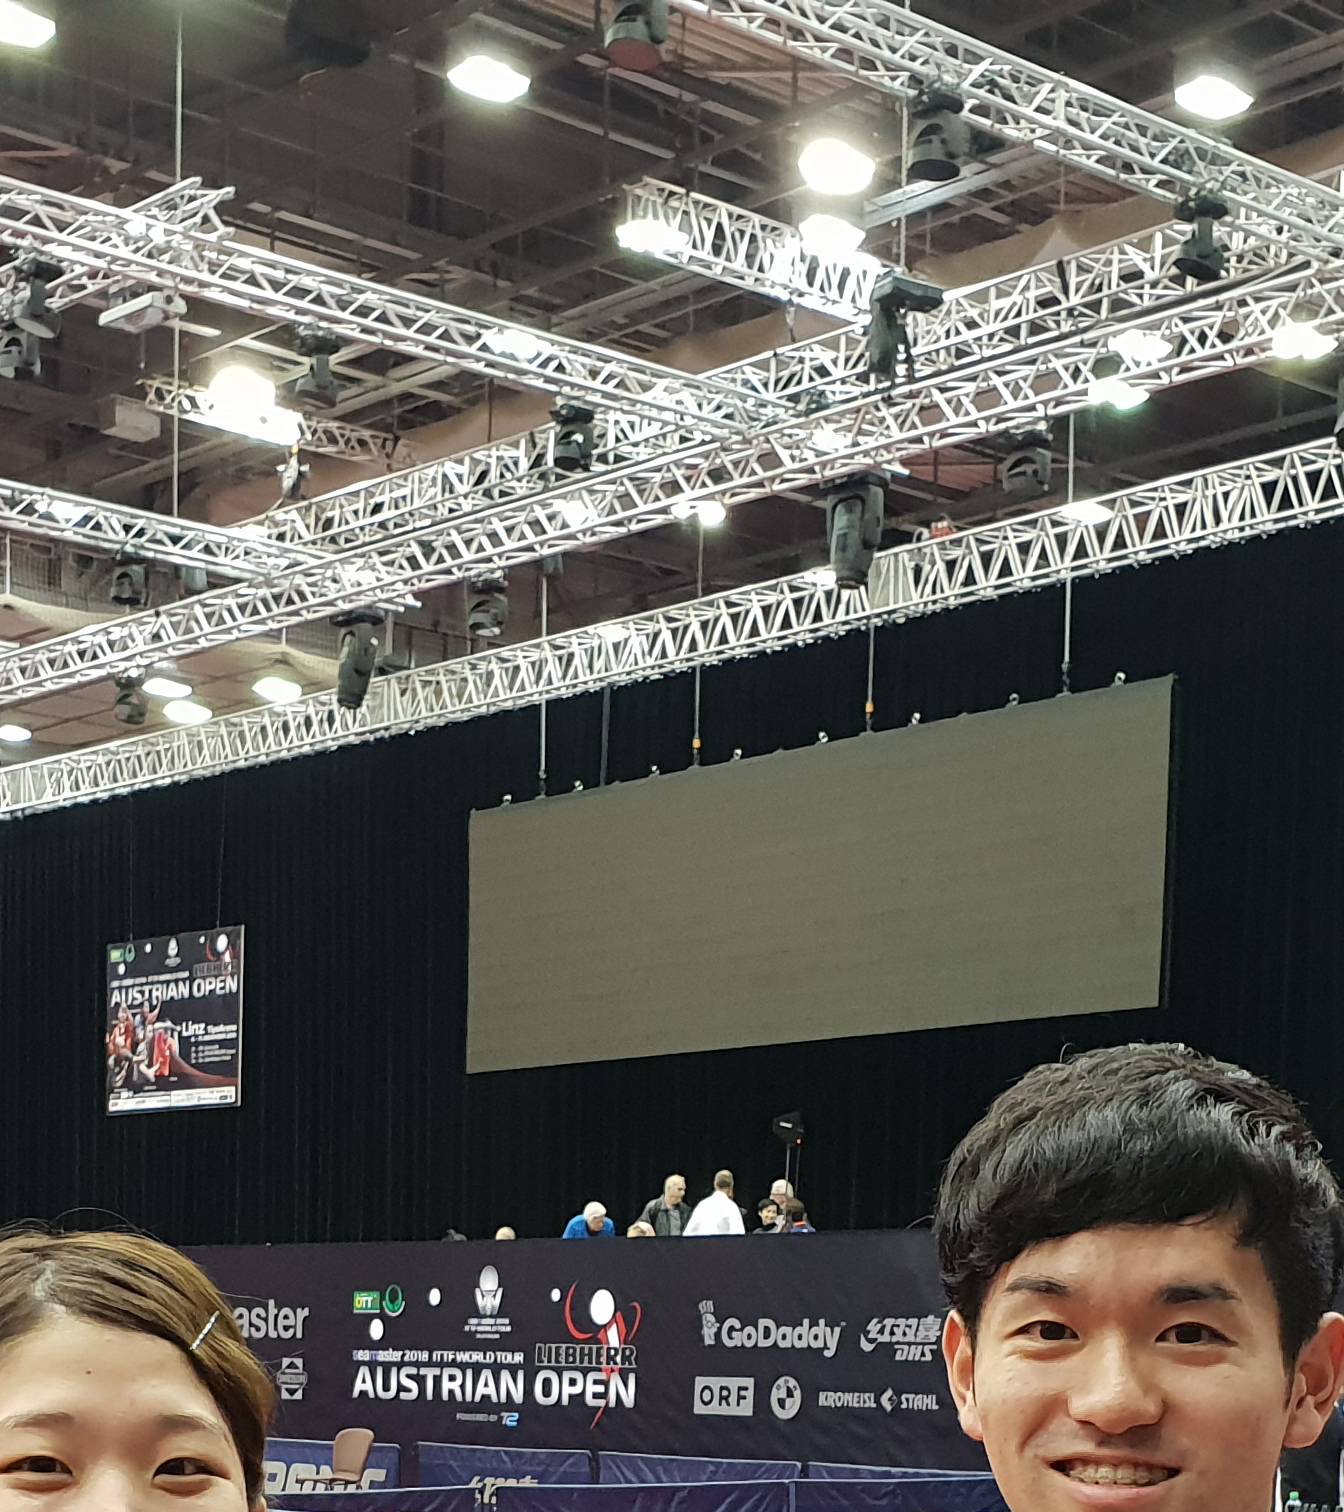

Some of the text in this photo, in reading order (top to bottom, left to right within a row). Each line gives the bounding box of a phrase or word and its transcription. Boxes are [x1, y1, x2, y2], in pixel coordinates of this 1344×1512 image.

[110, 980, 190, 1008] AUSTRIAN
[192, 974, 238, 998] OPEN
[182, 1020, 205, 1037] Linz
[721, 1317, 841, 1358] GoDaddy
[352, 1348, 524, 1364] seamaster 2018 ITTF WORLD TOUR
[534, 1343, 637, 1368] LIEBHERR
[894, 1344, 937, 1361] DHS
[352, 1365, 636, 1408] AUSTRIAN OPEN
[699, 1385, 749, 1408] ORF
[818, 1391, 939, 1411] KRONEISL STAHL
